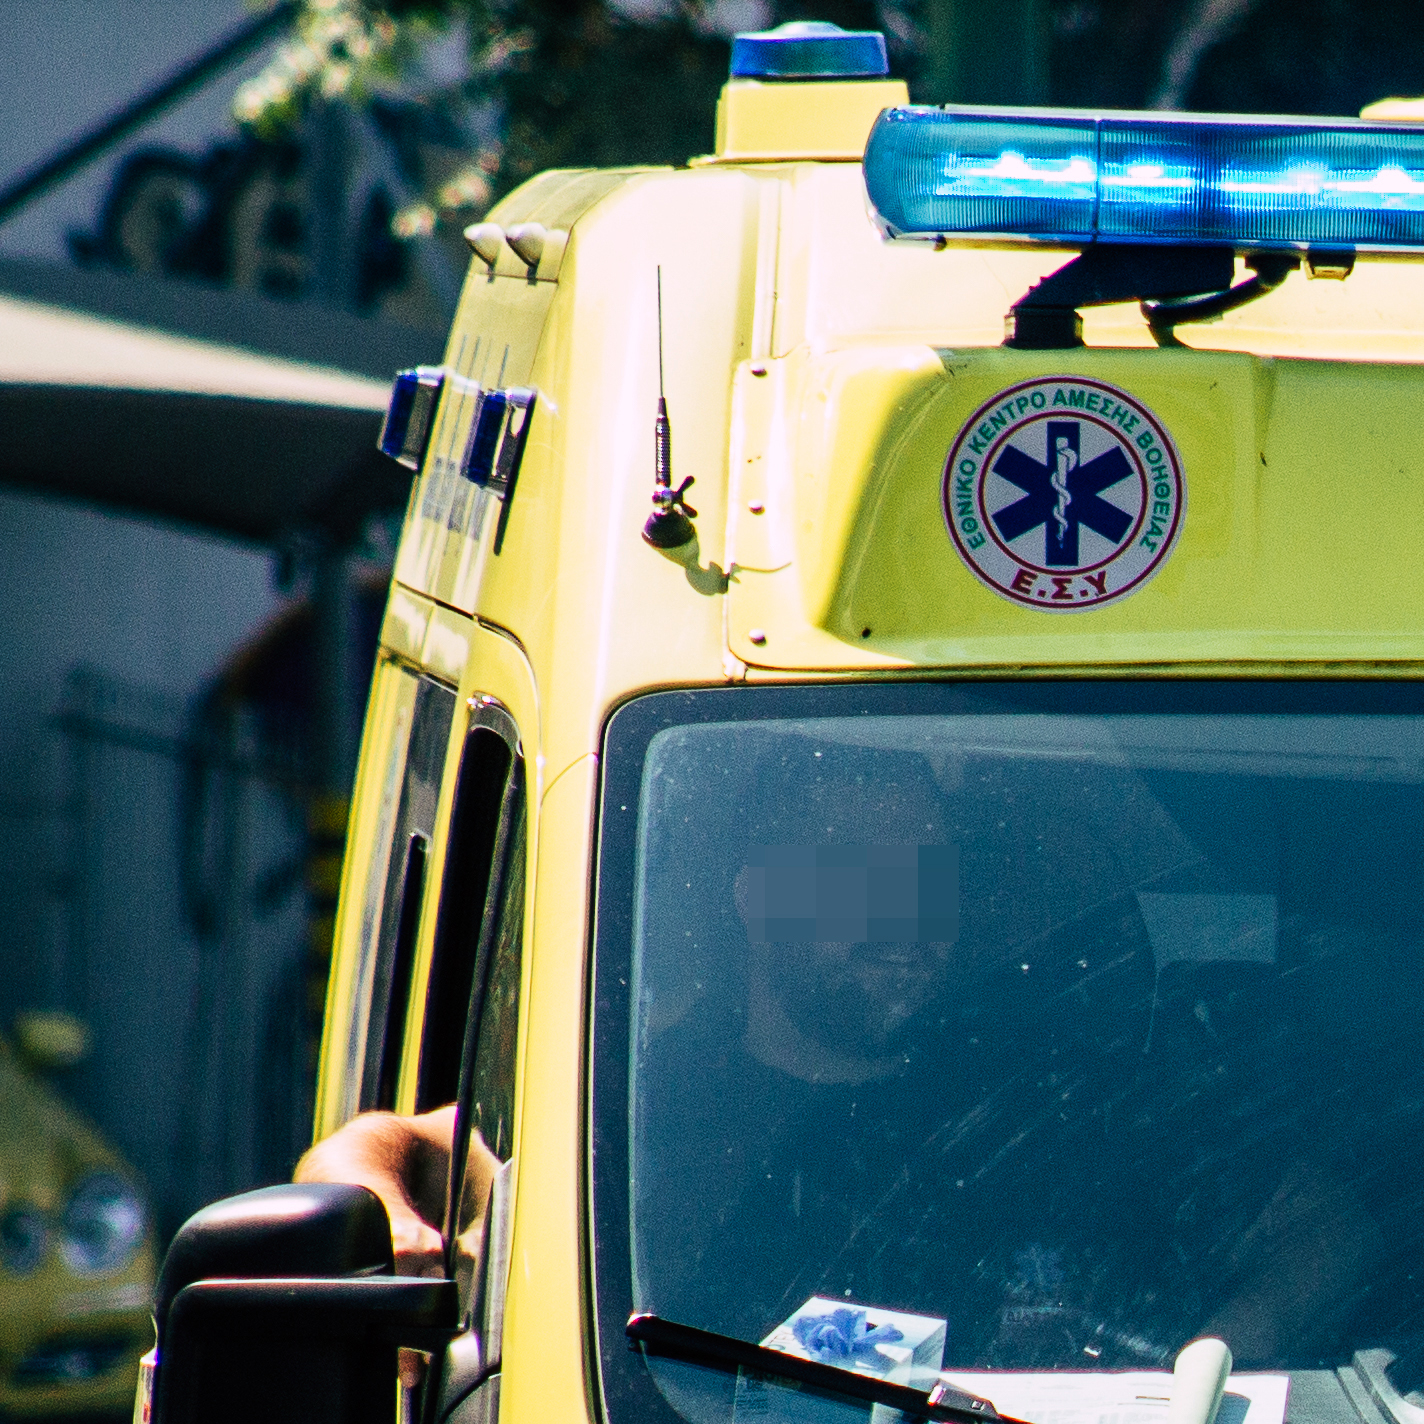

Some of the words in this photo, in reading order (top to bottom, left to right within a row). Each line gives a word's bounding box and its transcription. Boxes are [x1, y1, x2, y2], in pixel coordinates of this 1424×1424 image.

[967, 390, 1048, 456] ΚΕΝΤΡΟ
[1051, 388, 1142, 436] ΑΜΕΣΗΣ
[956, 457, 987, 551] ΕΘΝΙΚΟ
[1135, 429, 1172, 554] ΒΟΗΘΕΙΑΣ
[1009, 567, 1108, 600] Ε.Σ.Υ
